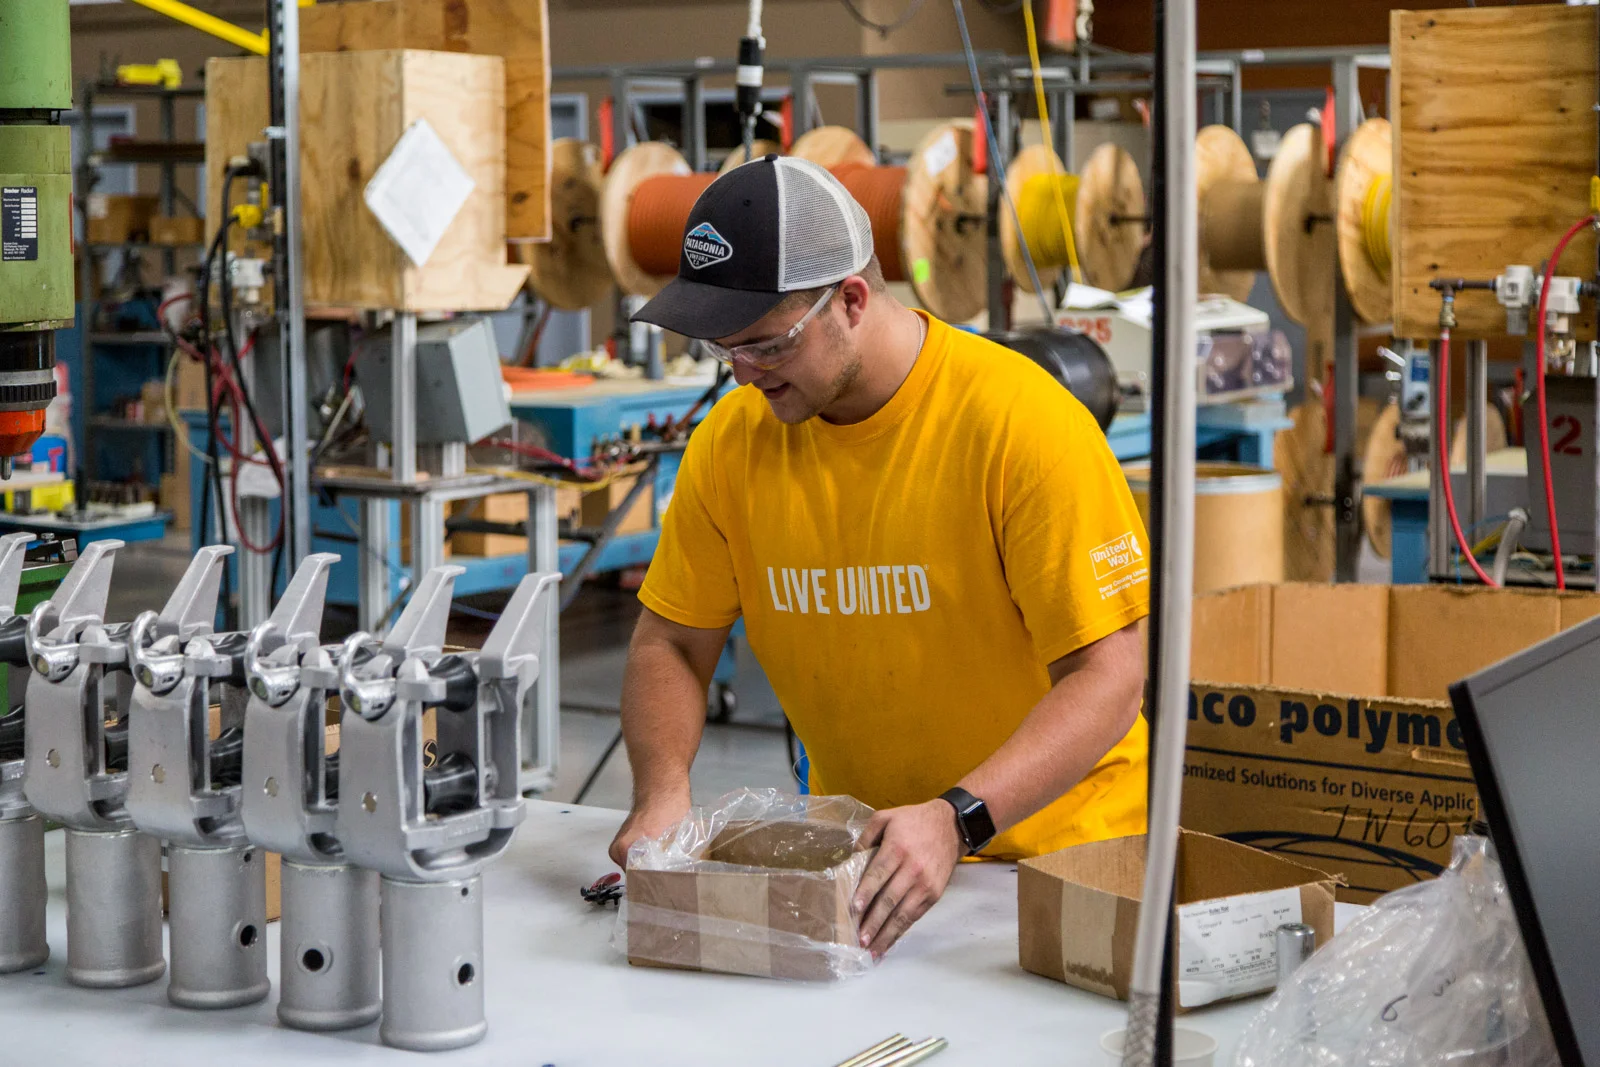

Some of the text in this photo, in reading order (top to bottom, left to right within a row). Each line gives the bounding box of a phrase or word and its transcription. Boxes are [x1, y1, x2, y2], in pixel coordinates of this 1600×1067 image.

[686, 238, 725, 257] PATAGONIA
[1552, 415, 1582, 456] 2
[1092, 539, 1127, 563] United
[1107, 552, 1129, 567] Way
[767, 564, 931, 615] LIVE UNITED
[1241, 767, 1317, 793] Solutions
[1321, 776, 1346, 795] for
[1351, 781, 1414, 804] Diverse
